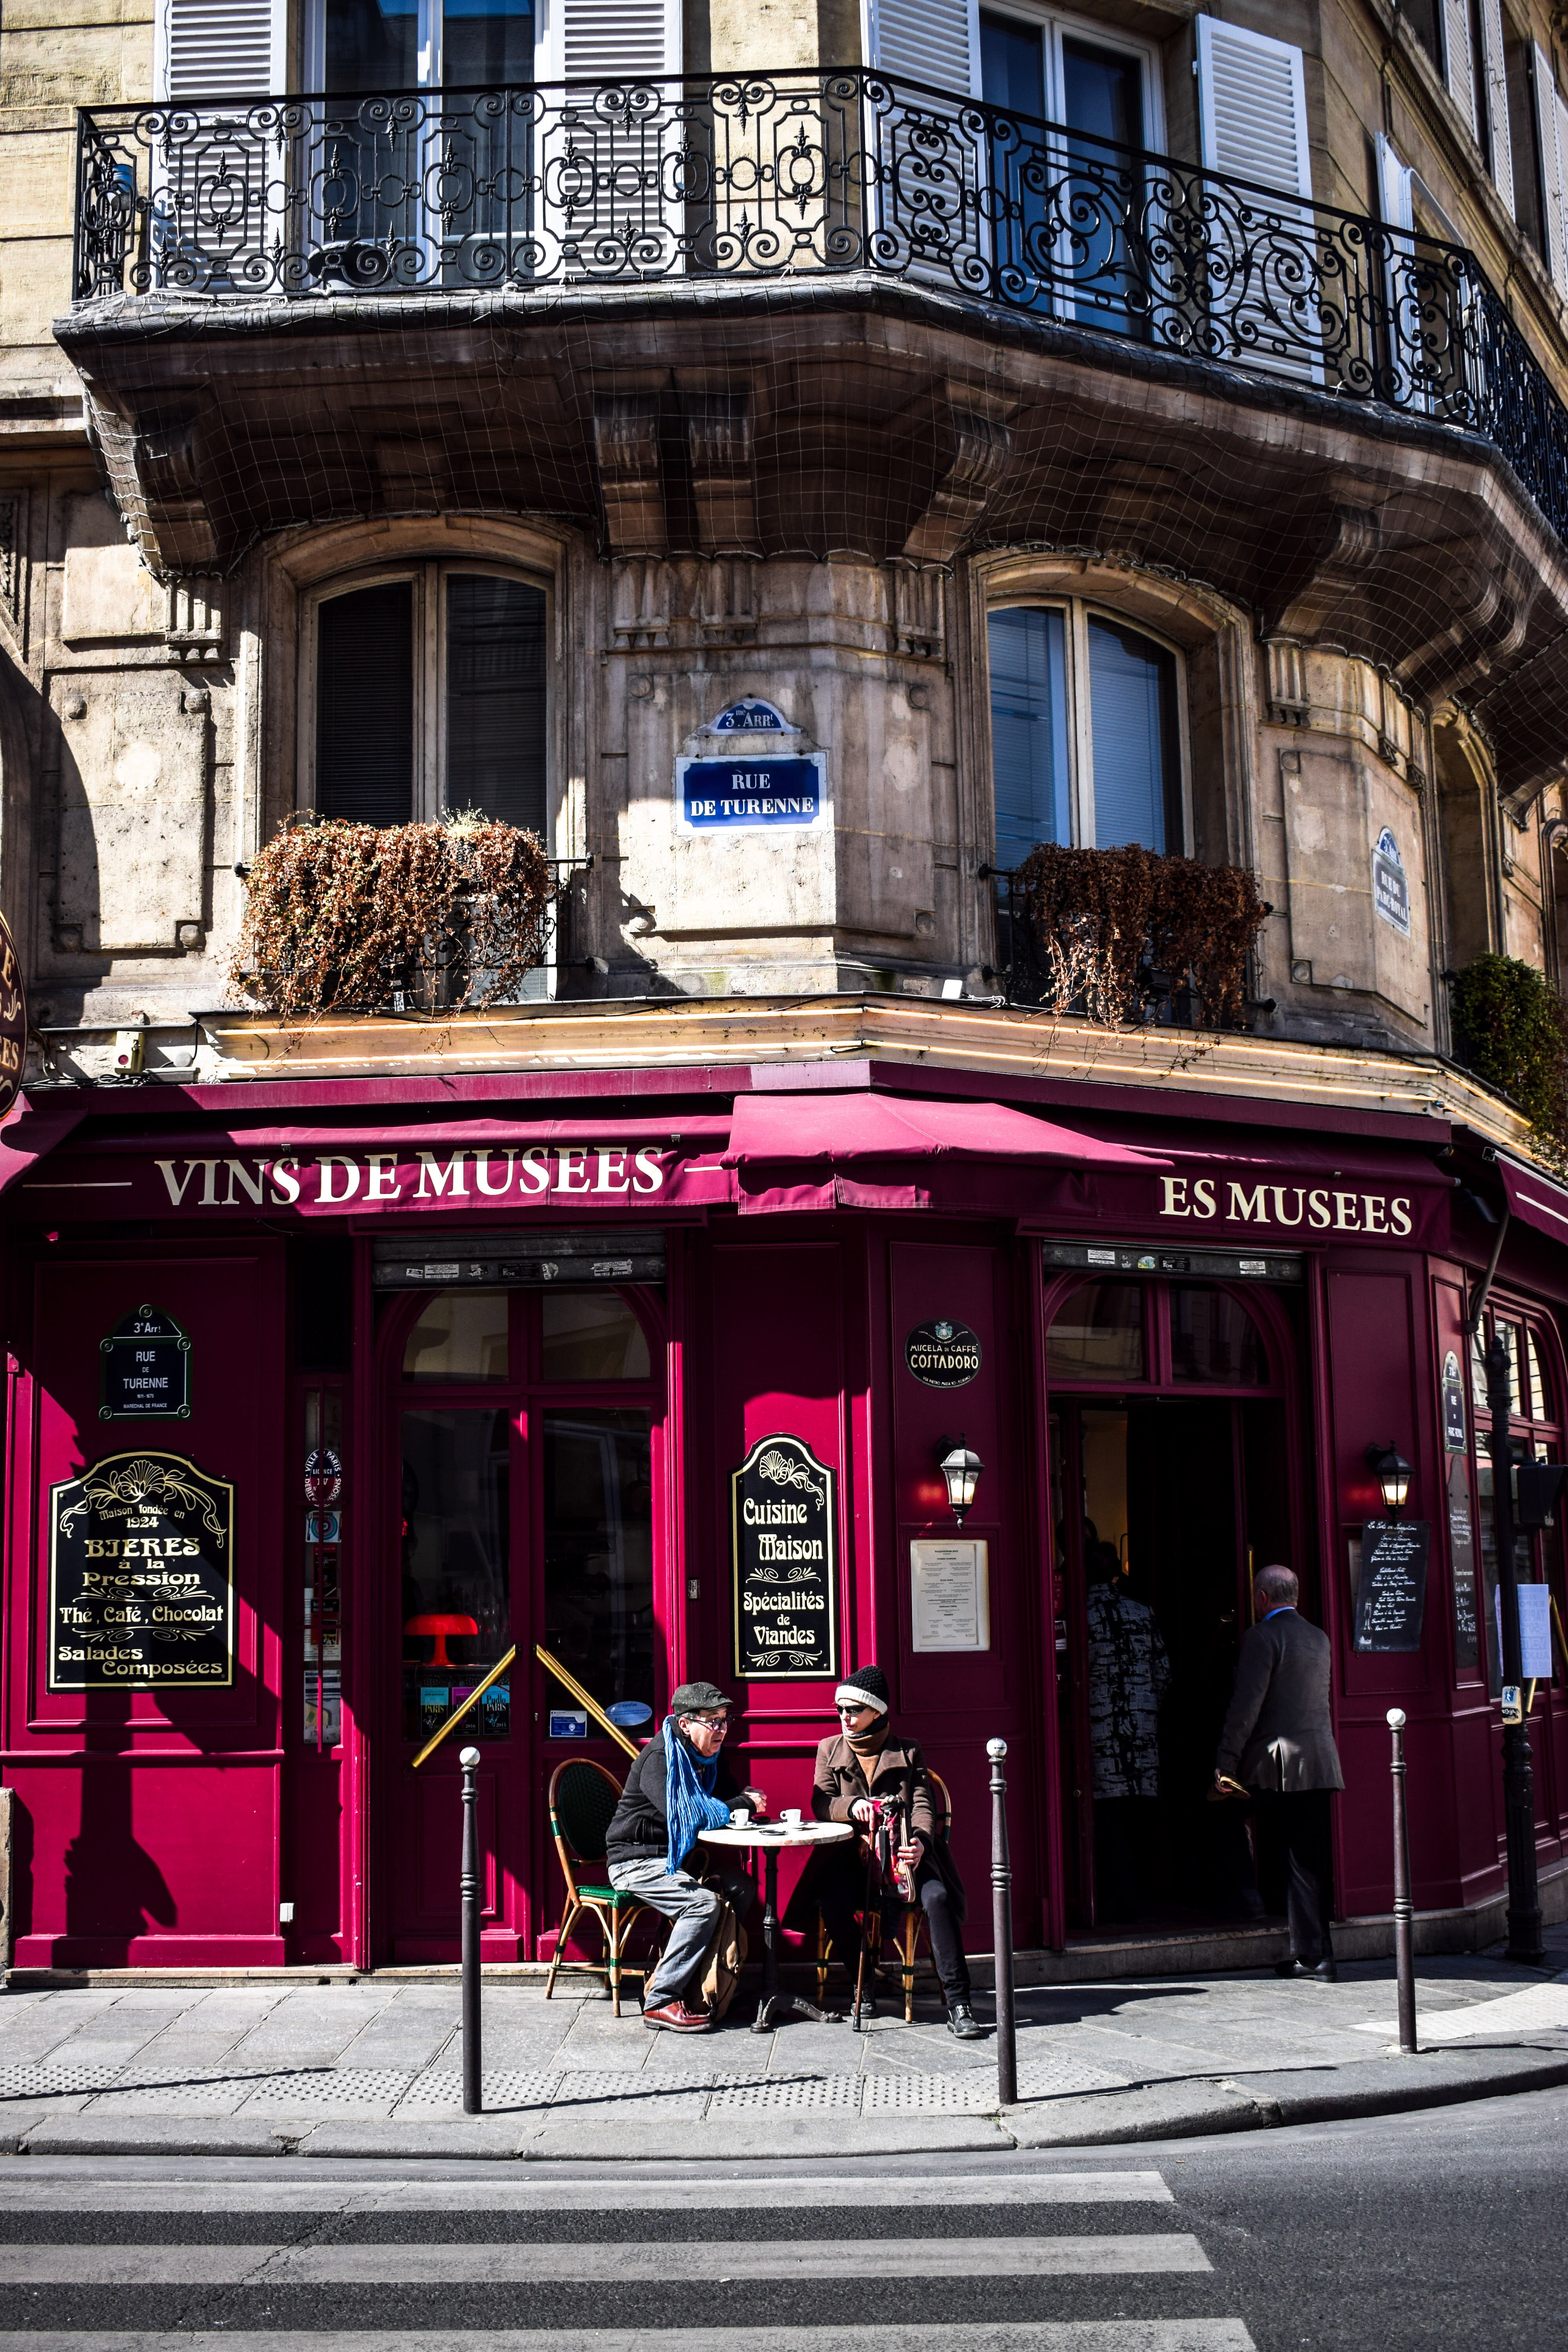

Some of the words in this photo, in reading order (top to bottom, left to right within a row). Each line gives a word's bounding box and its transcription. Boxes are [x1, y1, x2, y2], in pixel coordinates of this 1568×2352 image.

[732, 774, 770, 789] RUE
[690, 800, 716, 816] DE
[721, 797, 814, 815] TURENNE
[154, 1157, 301, 1206] VINS
[314, 1153, 402, 1203] DE
[413, 1147, 664, 1198] MUSEES
[1226, 1181, 1412, 1236] MUSEES
[136, 1351, 156, 1362] RUE
[911, 1354, 978, 1369] COSTADORO
[123, 1377, 169, 1389] TURENNE
[305, 1452, 318, 1472] VILLE
[326, 1451, 341, 1472] PARIS
[305, 1478, 314, 1497] DEBIT
[99, 1506, 132, 1520] Maison
[138, 1504, 168, 1515] fondée
[174, 1510, 185, 1519] en
[743, 1497, 808, 1525] Cuisine
[125, 1517, 159, 1528] 1924
[84, 1538, 200, 1557] BIERES
[758, 1534, 823, 1560] Maison
[118, 1559, 131, 1569] à
[146, 1559, 165, 1569] la
[82, 1572, 201, 1586] Pression
[743, 1591, 824, 1615] Spécialités
[152, 1605, 223, 1622] Chocolat
[777, 1614, 790, 1626] de
[753, 1625, 815, 1645] Viandes
[58, 1646, 143, 1661] Salades
[102, 1660, 223, 1678] Composées
[486, 1694, 506, 1704] Pudlo
[486, 1703, 506, 1711] PARIS
[425, 1705, 444, 1713] PARIS
